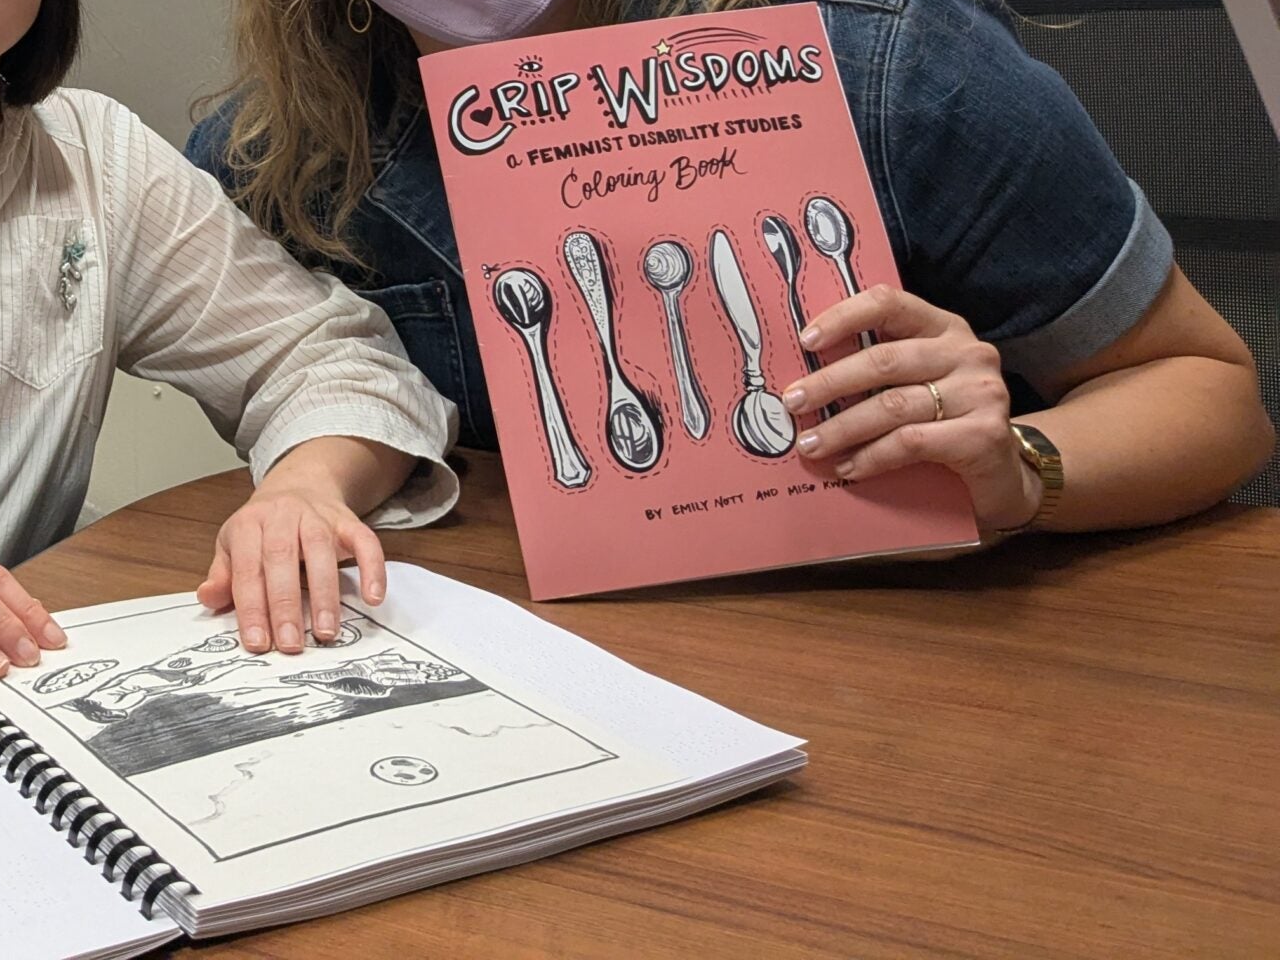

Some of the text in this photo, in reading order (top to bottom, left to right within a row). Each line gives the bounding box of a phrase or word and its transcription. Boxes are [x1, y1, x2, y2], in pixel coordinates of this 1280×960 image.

[447, 74, 580, 154] CRIP
[527, 135, 625, 168] FEMINIST
[628, 123, 721, 151] DISABILITY
[724, 113, 804, 138] STUDIES
[560, 147, 749, 209] Coloring Book
[644, 506, 664, 522] BY
[671, 499, 710, 516] EMILY
[754, 487, 780, 502] AND
[821, 475, 859, 491] KWA
